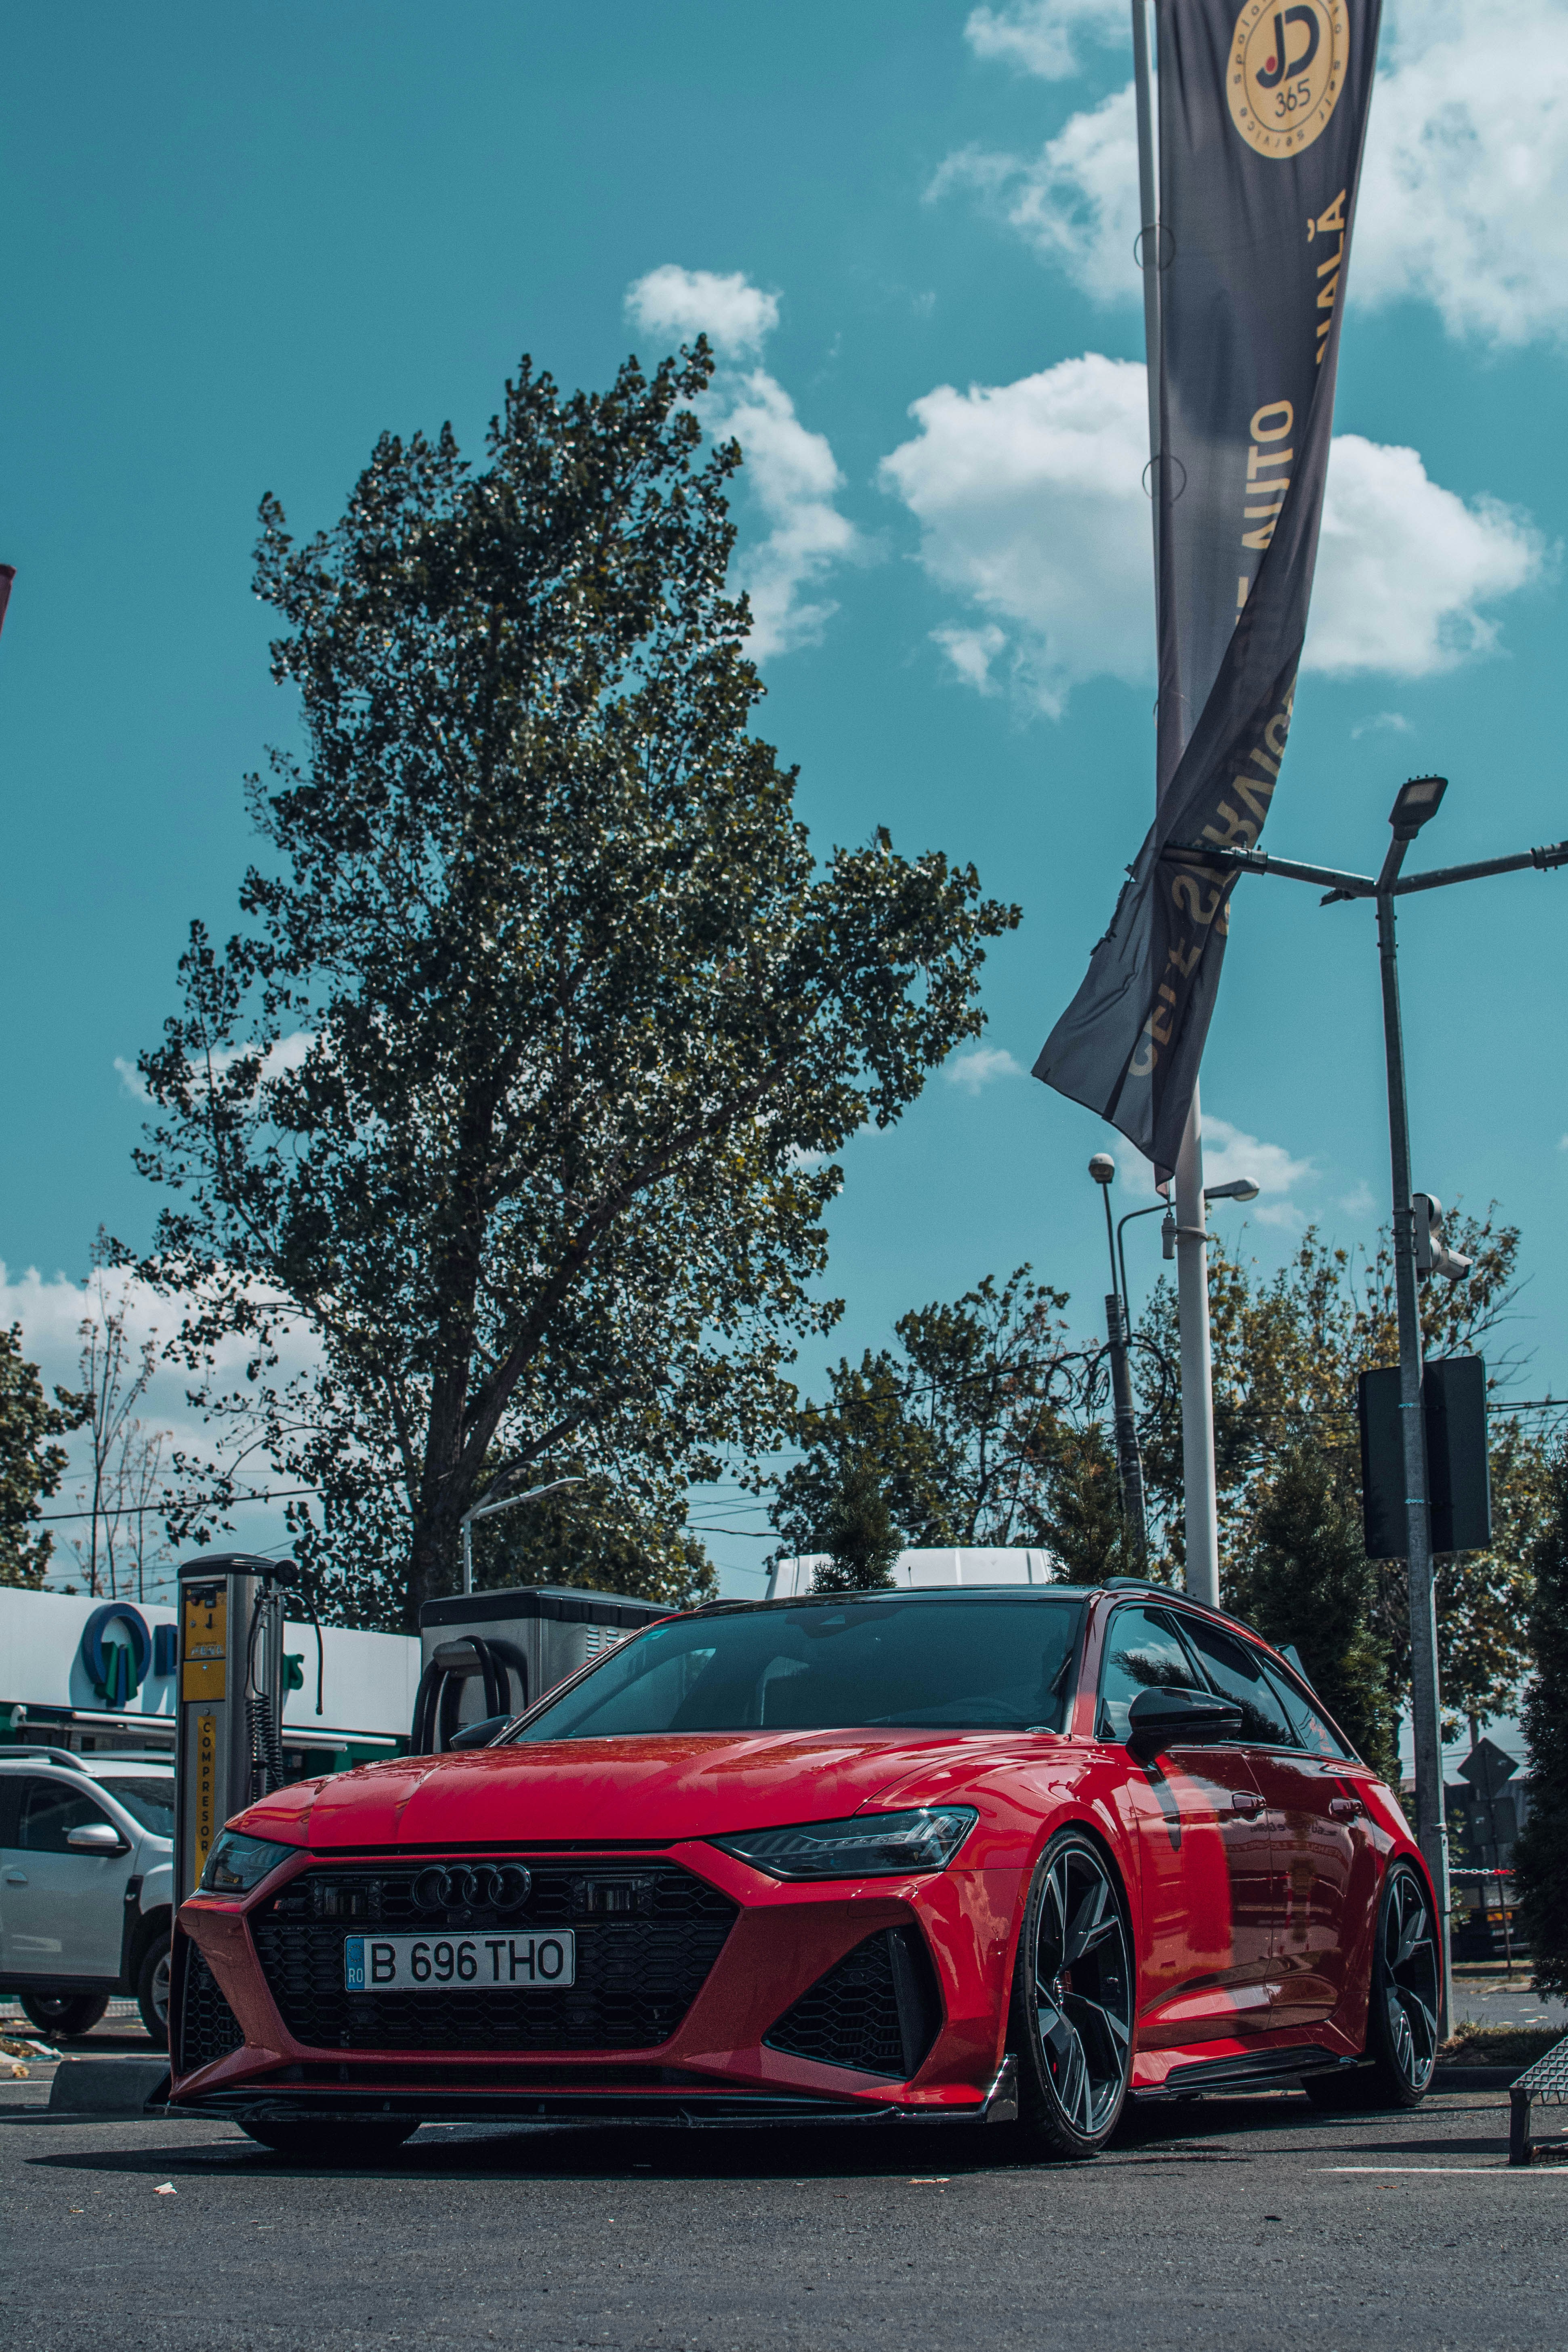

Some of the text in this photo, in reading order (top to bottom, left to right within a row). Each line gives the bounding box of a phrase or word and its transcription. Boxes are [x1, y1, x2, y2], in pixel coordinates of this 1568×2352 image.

[1275, 78, 1311, 117] 365
[1241, 400, 1294, 549] AUTO
[200, 1722, 211, 1851] COMPRESOR
[349, 1967, 363, 1983] RO
[371, 1938, 564, 1983] B 696 THO
